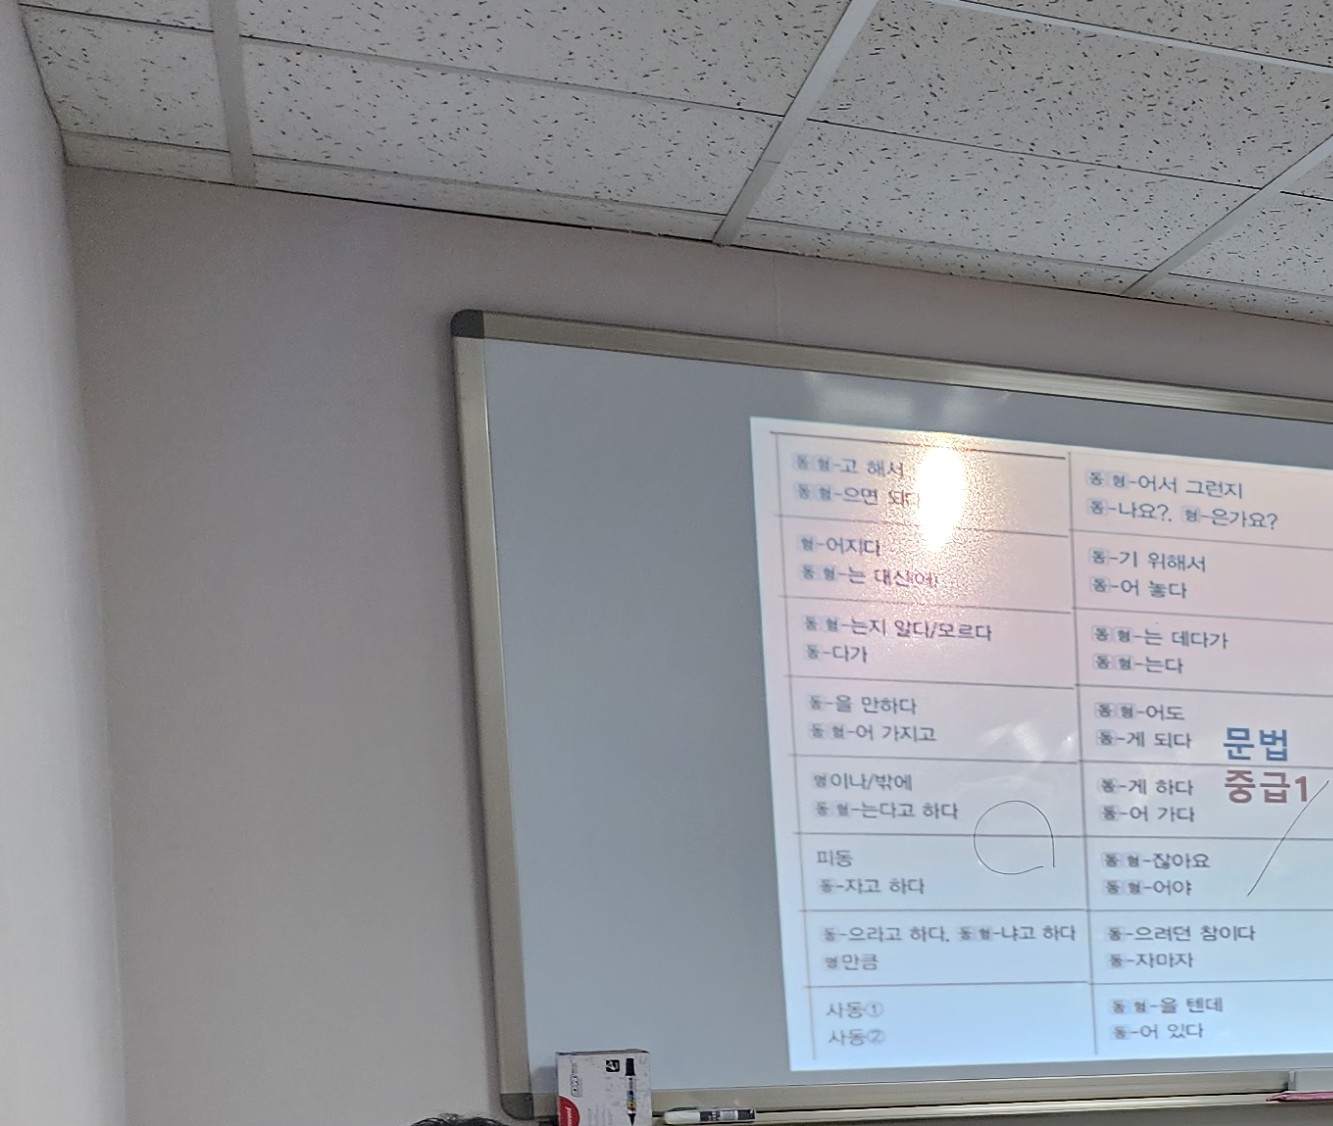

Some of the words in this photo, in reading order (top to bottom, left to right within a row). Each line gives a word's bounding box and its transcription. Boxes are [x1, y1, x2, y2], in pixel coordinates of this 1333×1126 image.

[868, 459, 904, 478] 해서
[1185, 479, 1243, 499] 그런지
[1147, 551, 1206, 573] 위해서
[894, 618, 992, 641] 알다/모르다
[1171, 630, 1228, 649] 데다가
[862, 697, 917, 715] 만하다
[882, 724, 936, 743] 가지고
[1153, 731, 1191, 750] 되다
[1223, 727, 1288, 760] 문법
[1155, 778, 1194, 796] 하다
[1224, 770, 1308, 805] 중급1
[922, 802, 958, 819] 하다
[1157, 805, 1195, 824] 가다
[816, 849, 853, 867] 피동
[889, 878, 925, 895] 하다
[1043, 923, 1076, 941] 하다
[1199, 923, 1256, 942] 참이다
[1186, 996, 1223, 1014] 텐데
[1166, 1022, 1204, 1041] 있다
